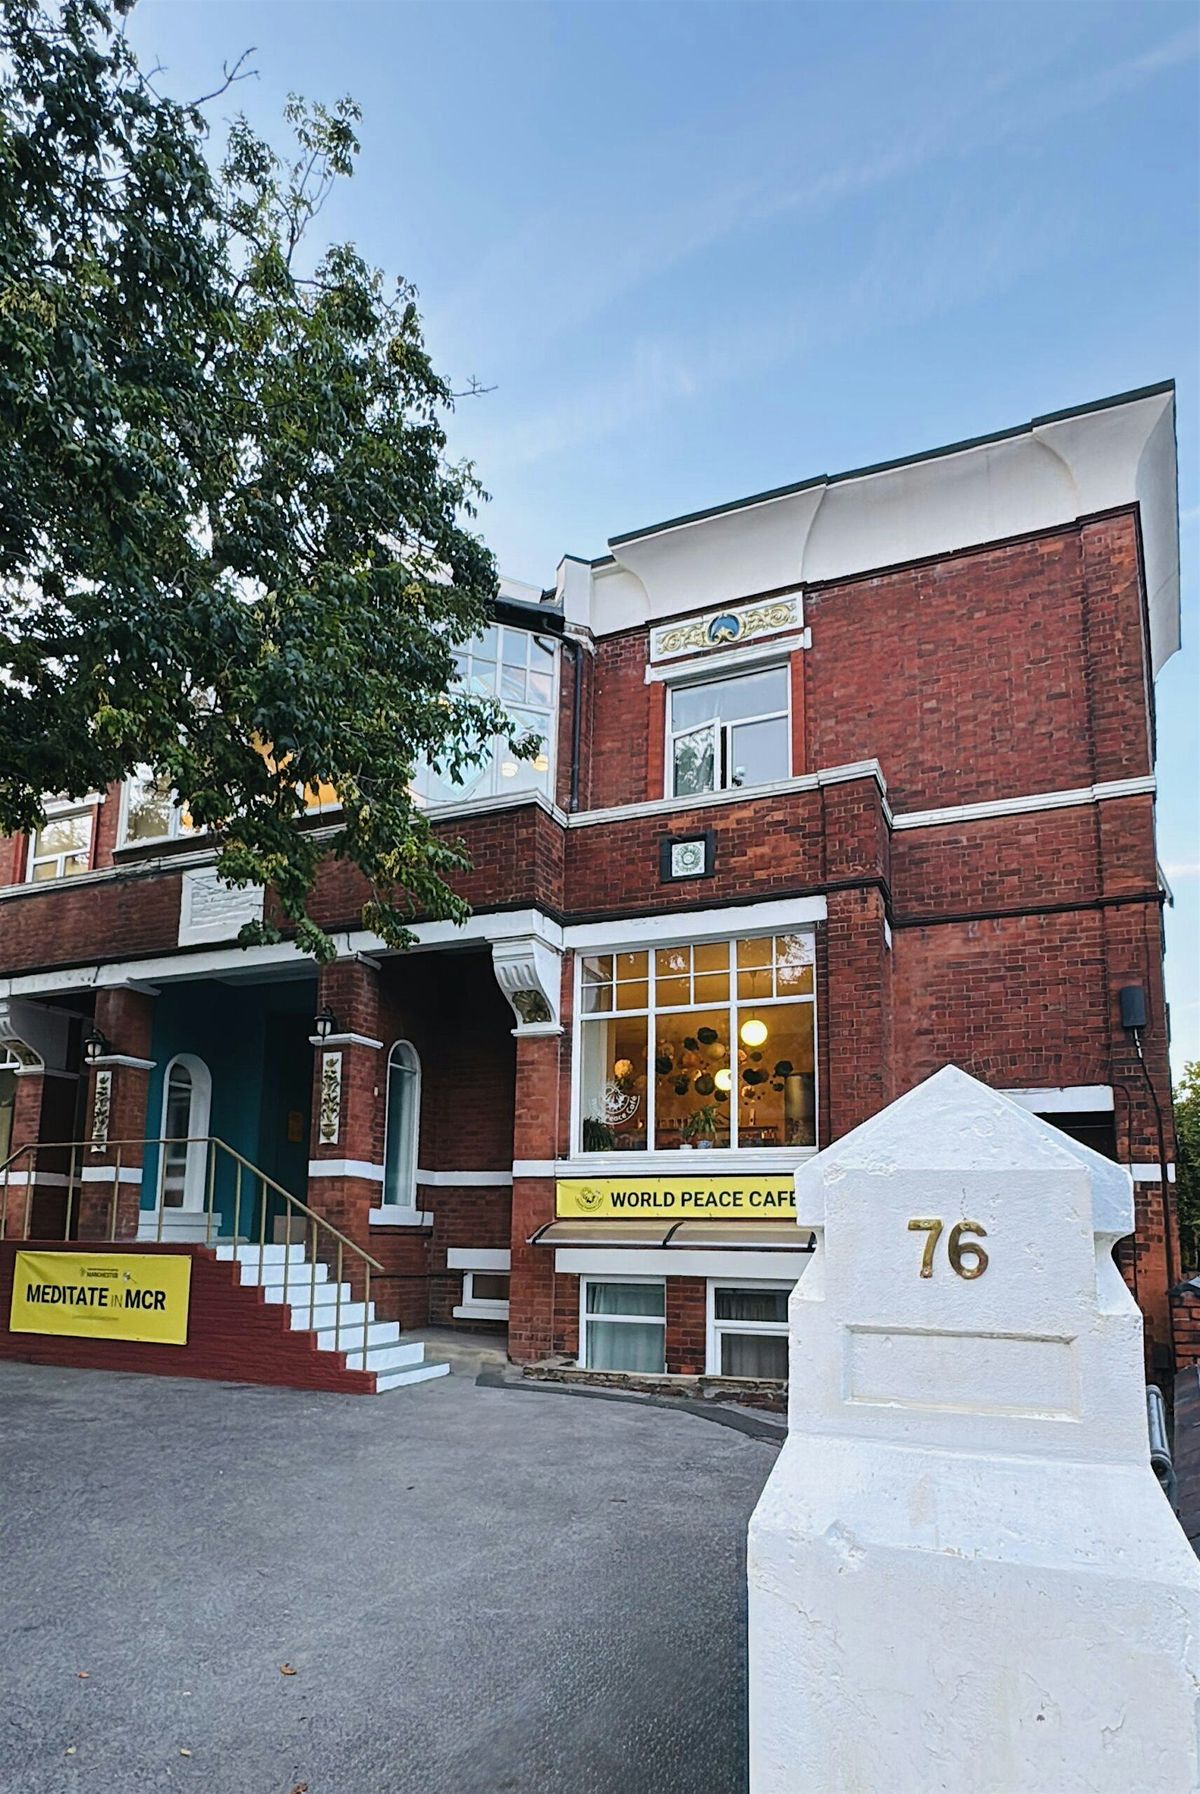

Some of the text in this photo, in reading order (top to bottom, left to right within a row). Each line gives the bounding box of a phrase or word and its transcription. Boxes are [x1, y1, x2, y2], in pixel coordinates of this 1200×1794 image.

[610, 1191, 675, 1208] WORLD
[680, 1191, 743, 1207] PEACE
[907, 1219, 989, 1280] 76
[26, 1284, 166, 1310] MEDITATE IN MCR
